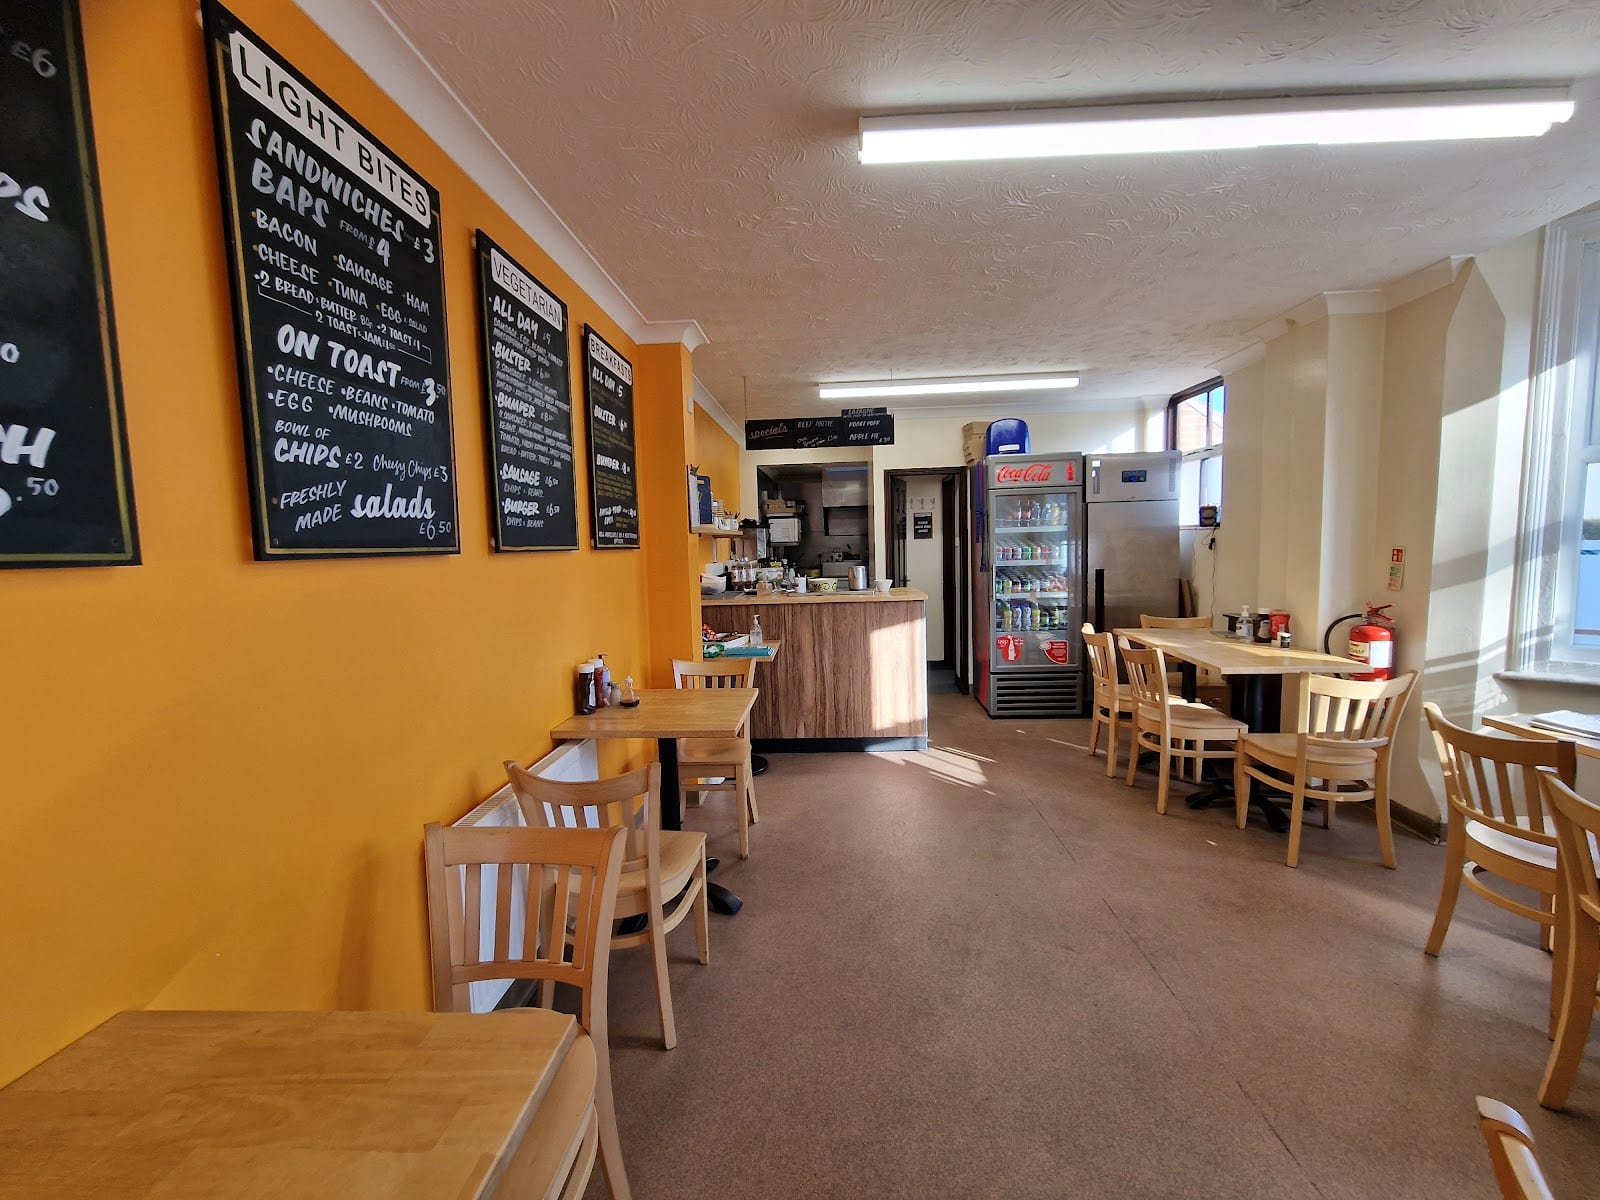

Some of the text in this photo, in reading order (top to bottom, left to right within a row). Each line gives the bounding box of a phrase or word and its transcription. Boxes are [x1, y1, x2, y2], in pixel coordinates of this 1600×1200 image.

[239, 44, 427, 217] LIGHT BITES
[245, 118, 435, 263] SANDWICHES £3
[251, 158, 390, 267] BAPS FROM £4
[256, 207, 430, 316] BACON SAUSAGE HAM
[258, 243, 319, 284] CHEESE
[331, 277, 368, 309] TUNA
[381, 302, 402, 324] EGG
[275, 276, 314, 304] BREAD
[320, 296, 357, 322] BUTTER
[388, 326, 413, 346] TOAST
[493, 256, 561, 329] VEGETARIAN
[315, 310, 323, 323] 2
[326, 315, 358, 338] TOAST
[361, 330, 382, 348] JAM
[492, 294, 514, 322] ALL
[517, 310, 539, 341] DAY
[277, 323, 401, 388] ON TOAST
[495, 341, 532, 372] BUSTER
[590, 337, 632, 382] BREAKFASTS
[274, 363, 435, 424] CHEESE BEANS TOMATO
[400, 376, 420, 390] FROM
[498, 391, 536, 418] BUMPER
[274, 419, 331, 440] BOWL OF
[275, 389, 412, 437] EGG MUSHROOMS
[749, 422, 789, 440] specials
[274, 437, 342, 469] CHIPS
[345, 451, 364, 470] £2
[433, 465, 448, 483] £3
[501, 462, 541, 487] SAUSAGE
[997, 464, 1054, 483] Coca-Cola
[280, 479, 347, 510] FRESHLY
[295, 482, 436, 532] MADE salads
[504, 497, 540, 517] BURGER
